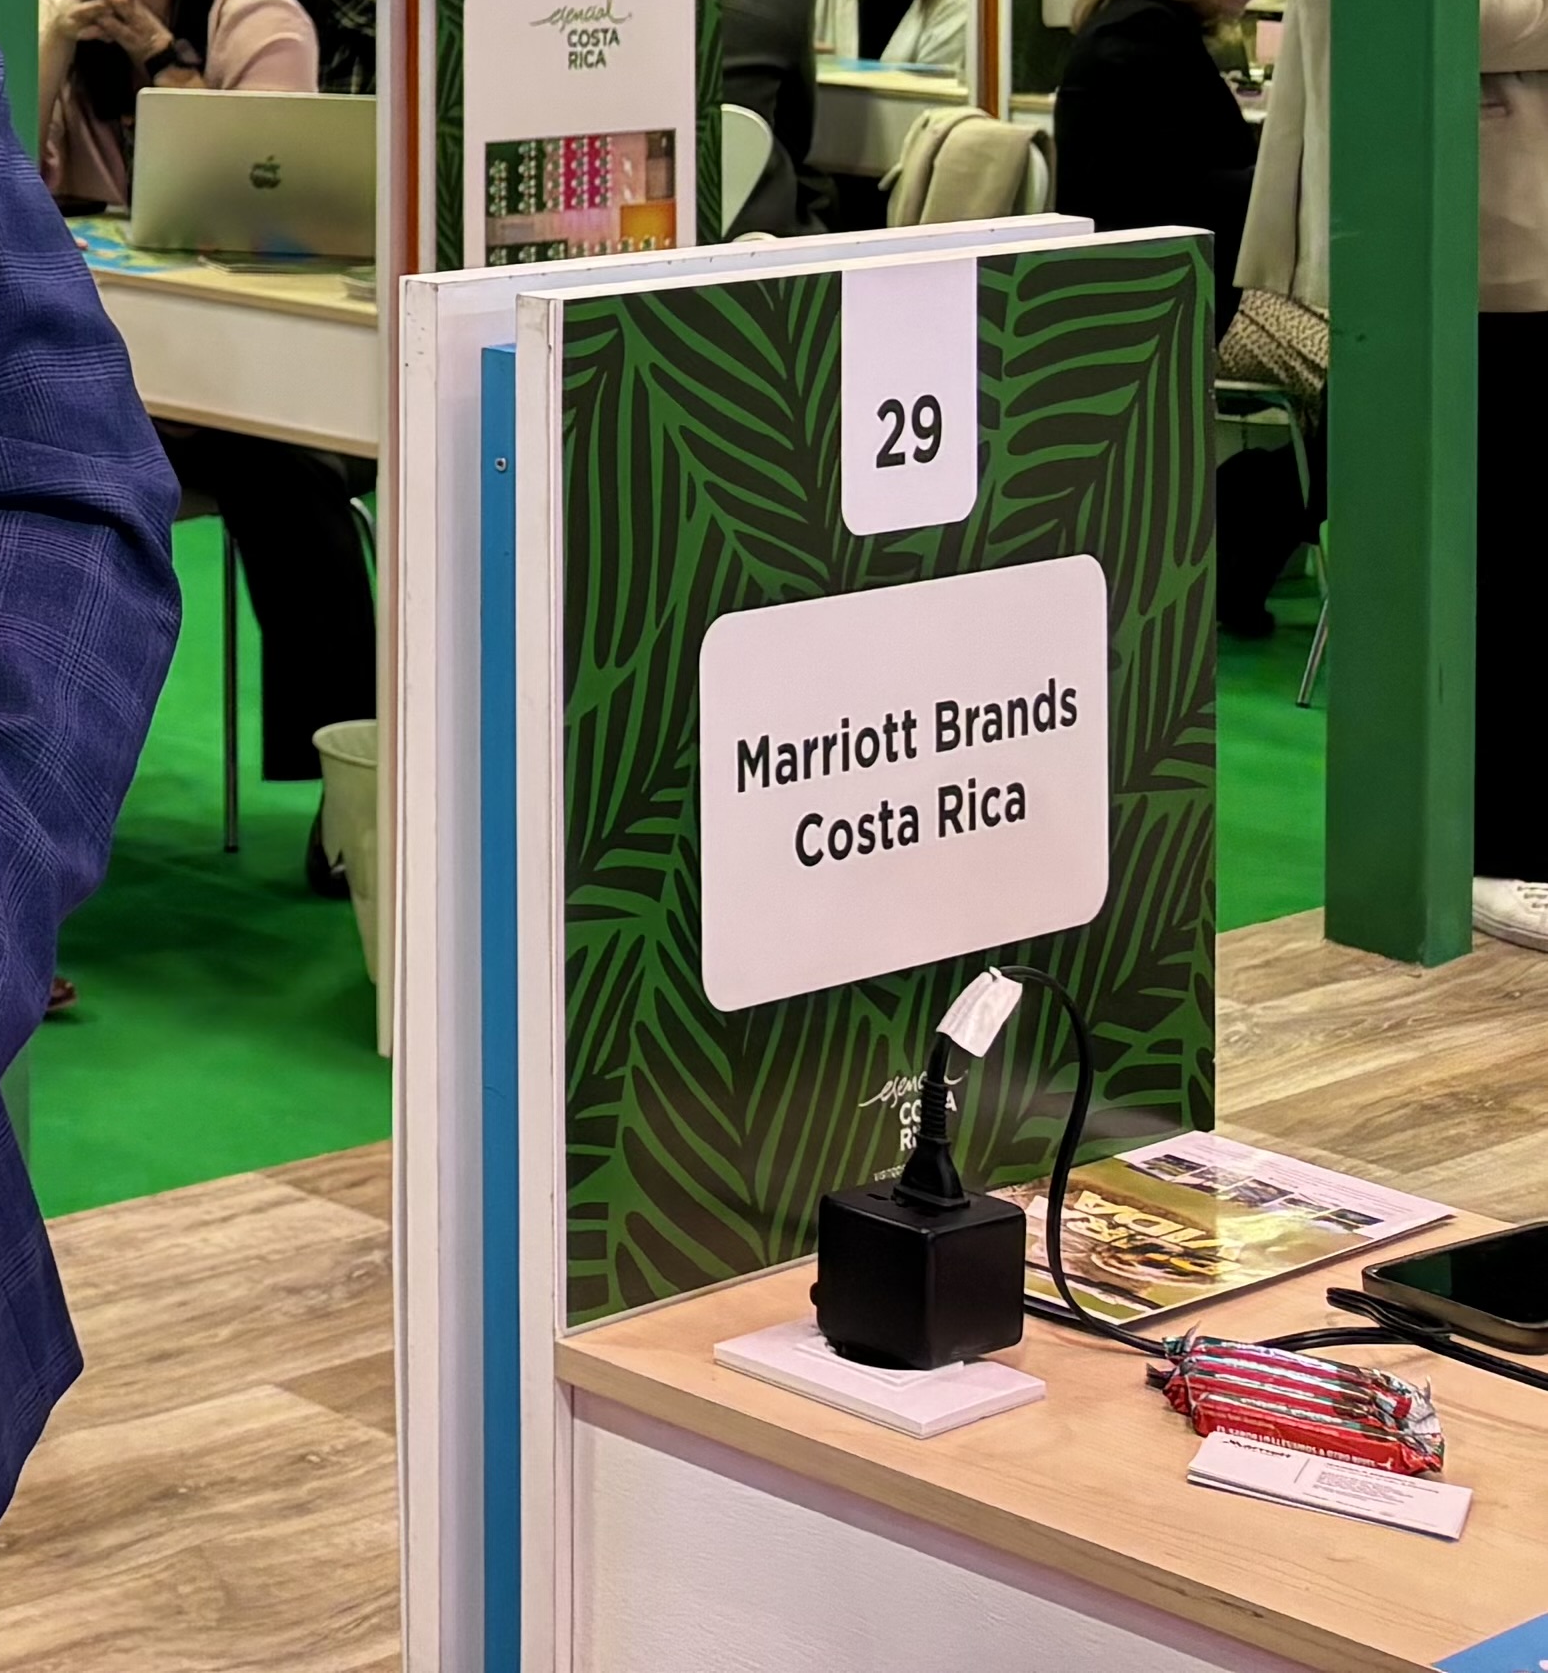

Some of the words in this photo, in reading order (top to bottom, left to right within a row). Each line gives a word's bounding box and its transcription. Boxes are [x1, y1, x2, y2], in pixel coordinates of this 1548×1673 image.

[567, 27, 621, 48] COSTA
[567, 49, 607, 70] RICA
[874, 394, 944, 470] 29
[736, 708, 918, 794] Marriott
[934, 677, 1078, 754] Brands
[794, 799, 920, 868] Costa
[937, 777, 1027, 839] Rica
[899, 1090, 958, 1126] COA
